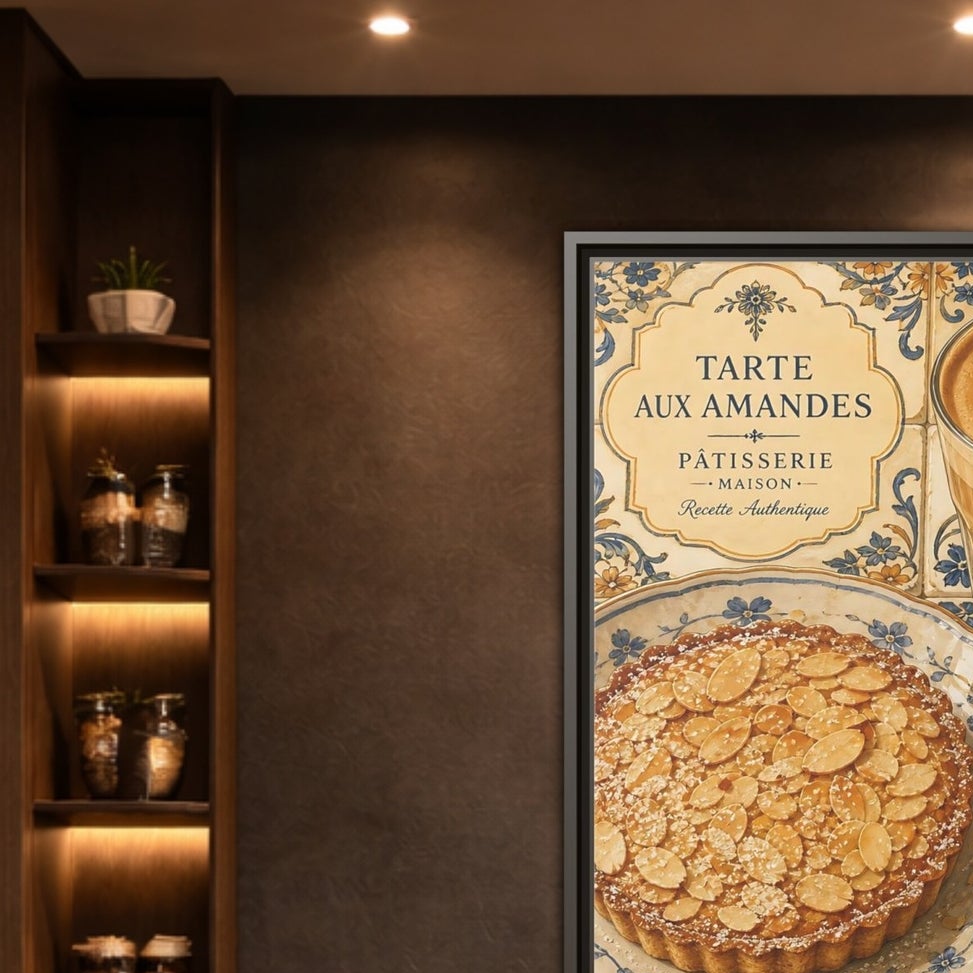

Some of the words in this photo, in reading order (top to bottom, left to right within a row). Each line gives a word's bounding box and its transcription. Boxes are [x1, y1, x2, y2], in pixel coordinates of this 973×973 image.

[695, 355, 813, 381] TARTE
[633, 394, 692, 419] AUX
[701, 393, 872, 419] AMANDES
[678, 448, 833, 470] PÂTISSERIE
[718, 477, 792, 490] MAISON
[678, 498, 733, 520] Recette
[739, 498, 830, 522] Authentique
